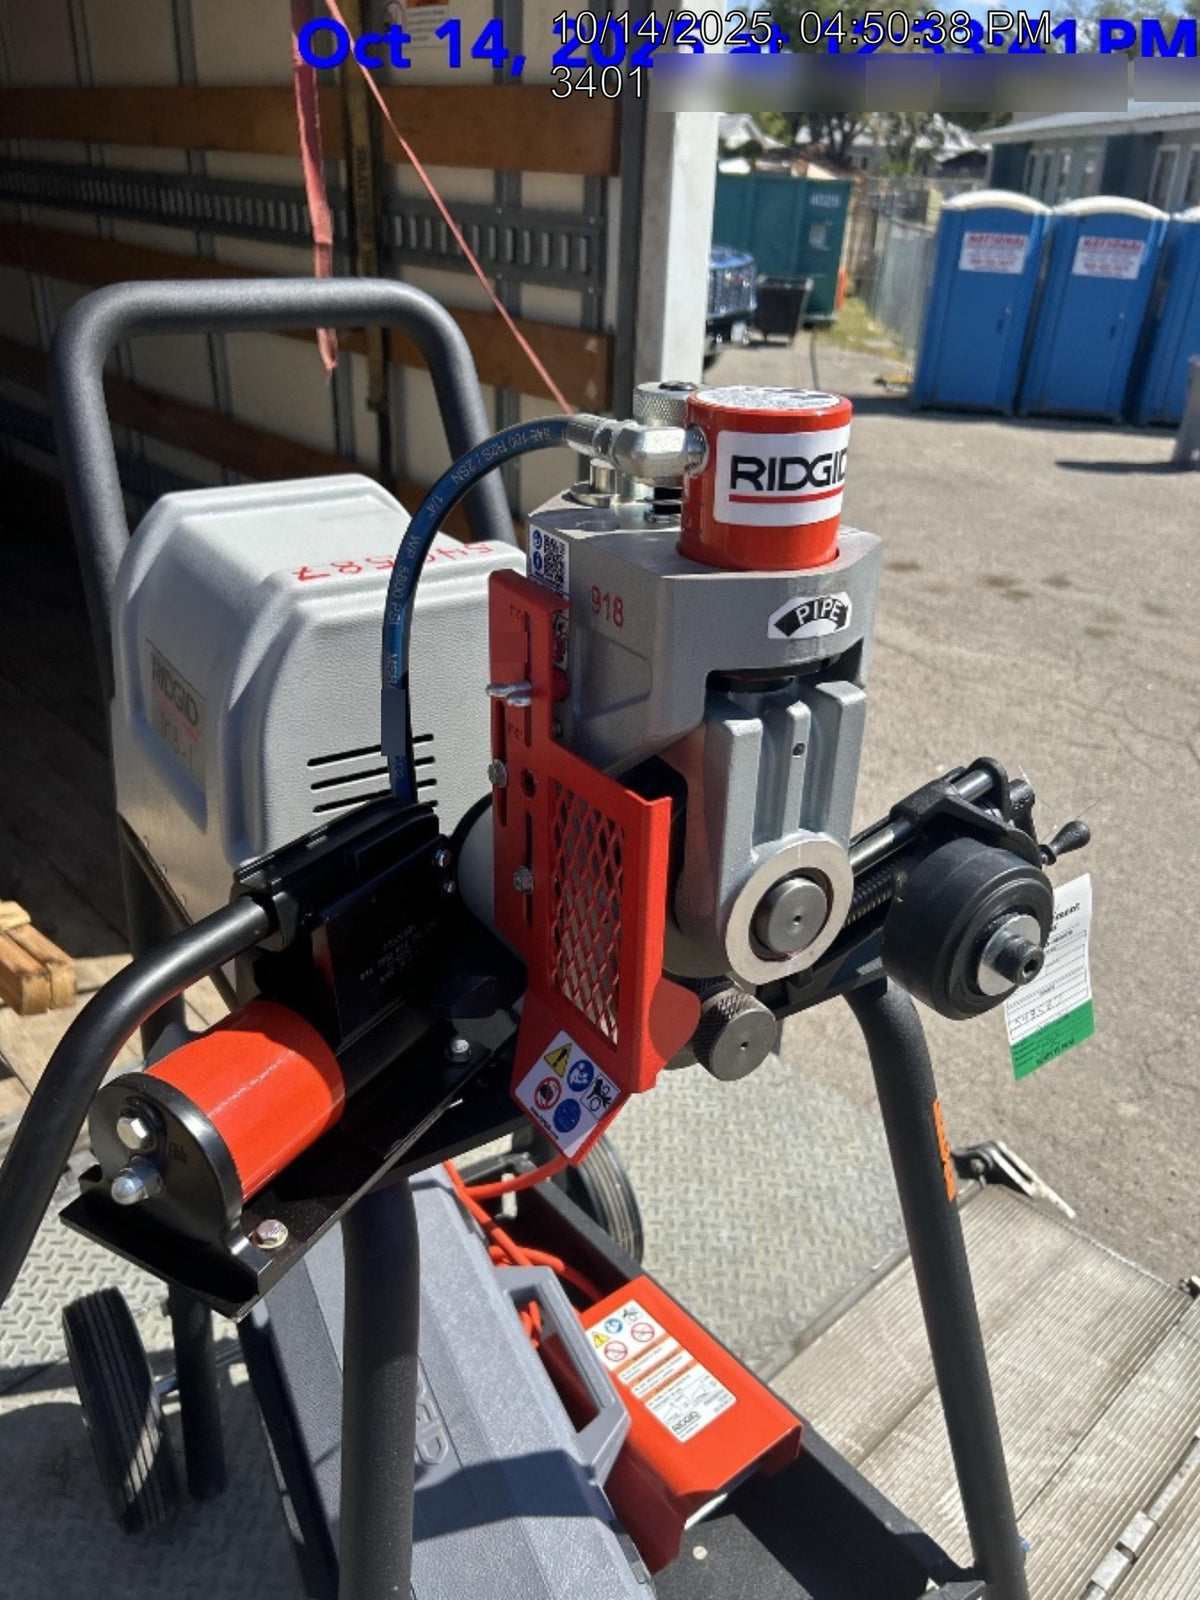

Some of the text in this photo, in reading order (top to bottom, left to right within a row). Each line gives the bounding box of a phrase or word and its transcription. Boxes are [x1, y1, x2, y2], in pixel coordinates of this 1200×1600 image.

[730, 447, 848, 492] RIDGID
[590, 584, 625, 628] 918
[795, 598, 843, 625] PIPE
[150, 651, 199, 727] RIDGID
